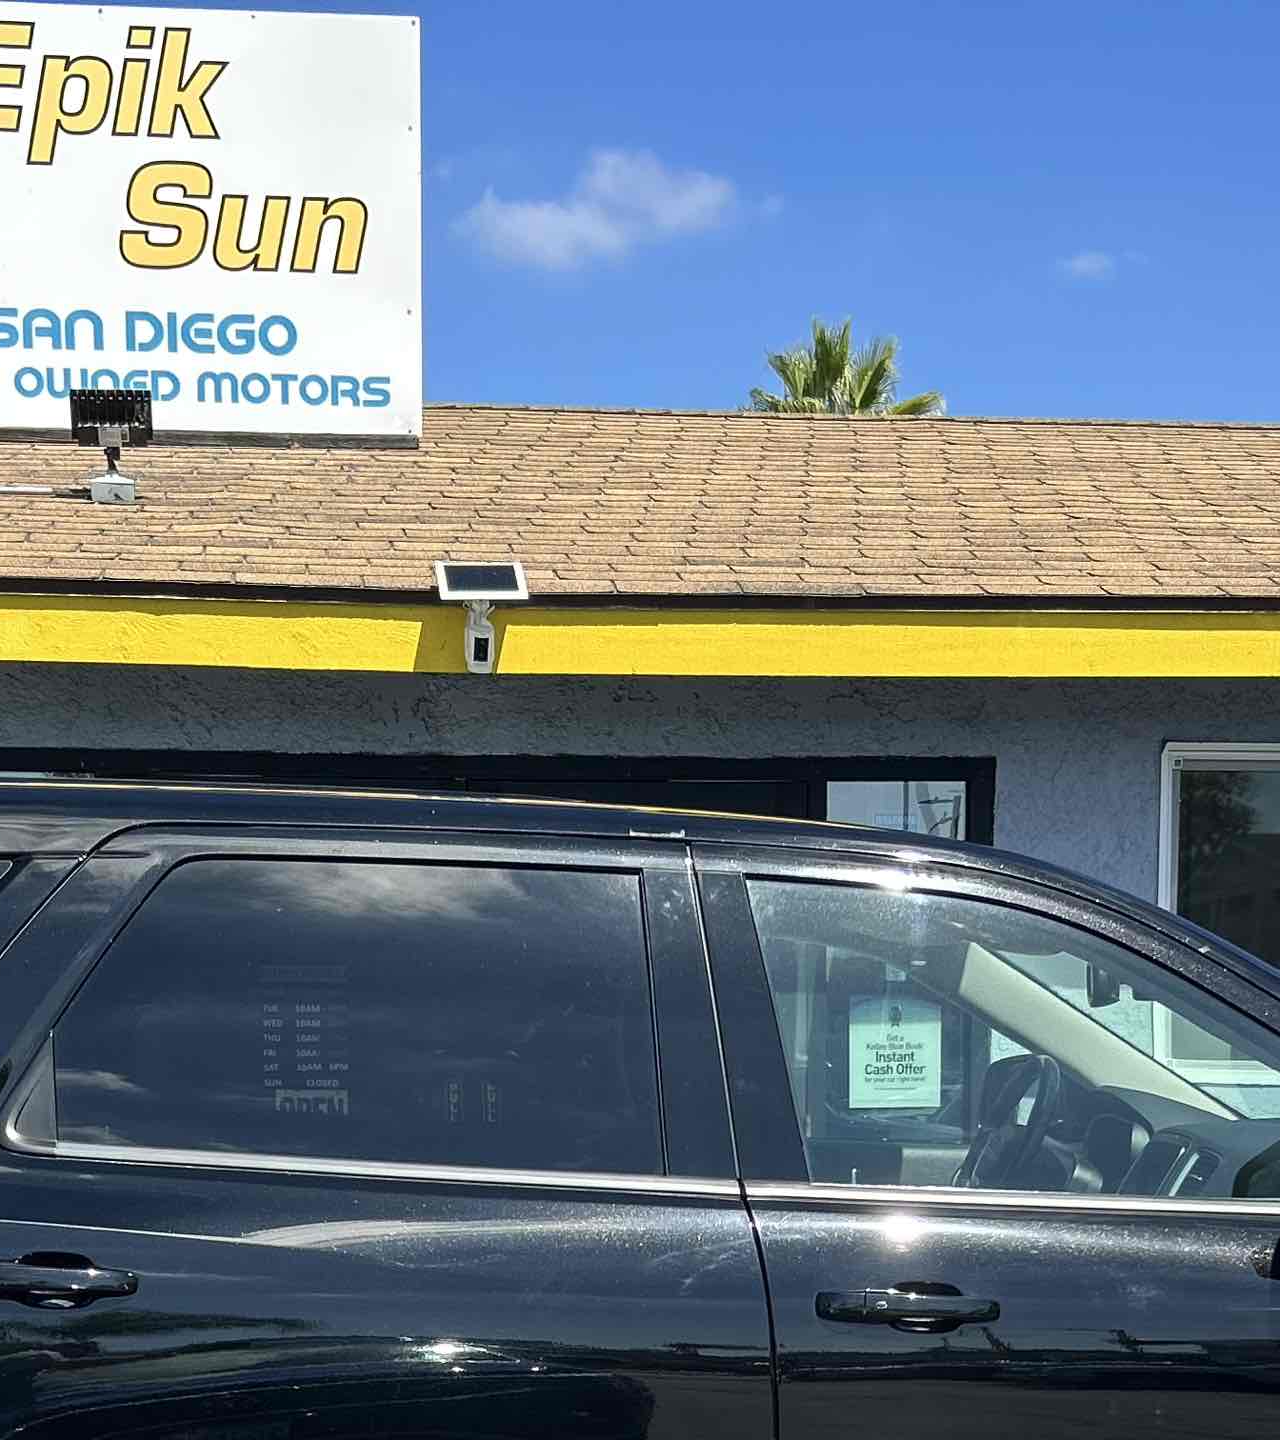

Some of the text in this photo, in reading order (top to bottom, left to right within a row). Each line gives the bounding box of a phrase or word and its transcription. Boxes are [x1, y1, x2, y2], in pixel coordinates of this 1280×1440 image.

[119, 159, 369, 274] Sun
[125, 310, 298, 356] DIEGO
[14, 366, 181, 401] OWNED
[197, 371, 391, 407] MOTORS
[865, 1063, 927, 1075] Cash Offer
[876, 1051, 914, 1062] Instant
